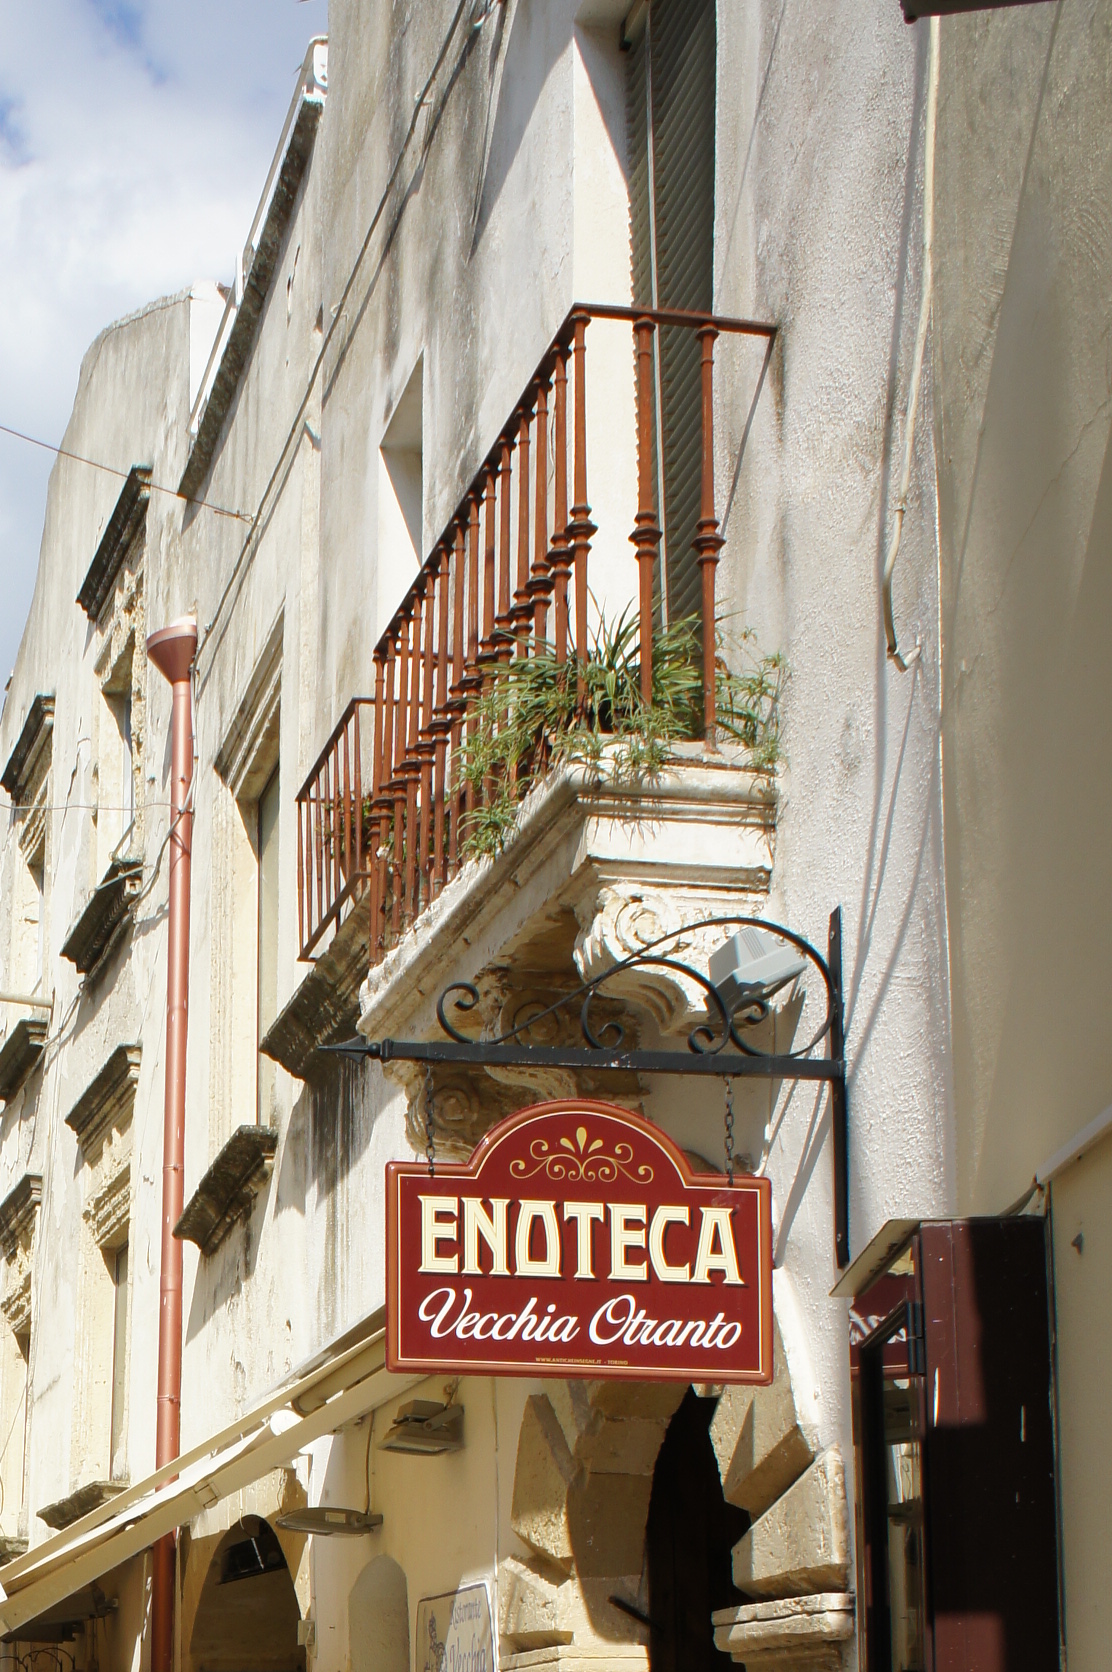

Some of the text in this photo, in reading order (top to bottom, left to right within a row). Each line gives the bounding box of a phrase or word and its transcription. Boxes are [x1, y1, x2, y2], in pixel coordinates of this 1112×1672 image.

[417, 1195, 745, 1286] ENOTECA
[418, 1287, 742, 1349] Vecchia Otranto
